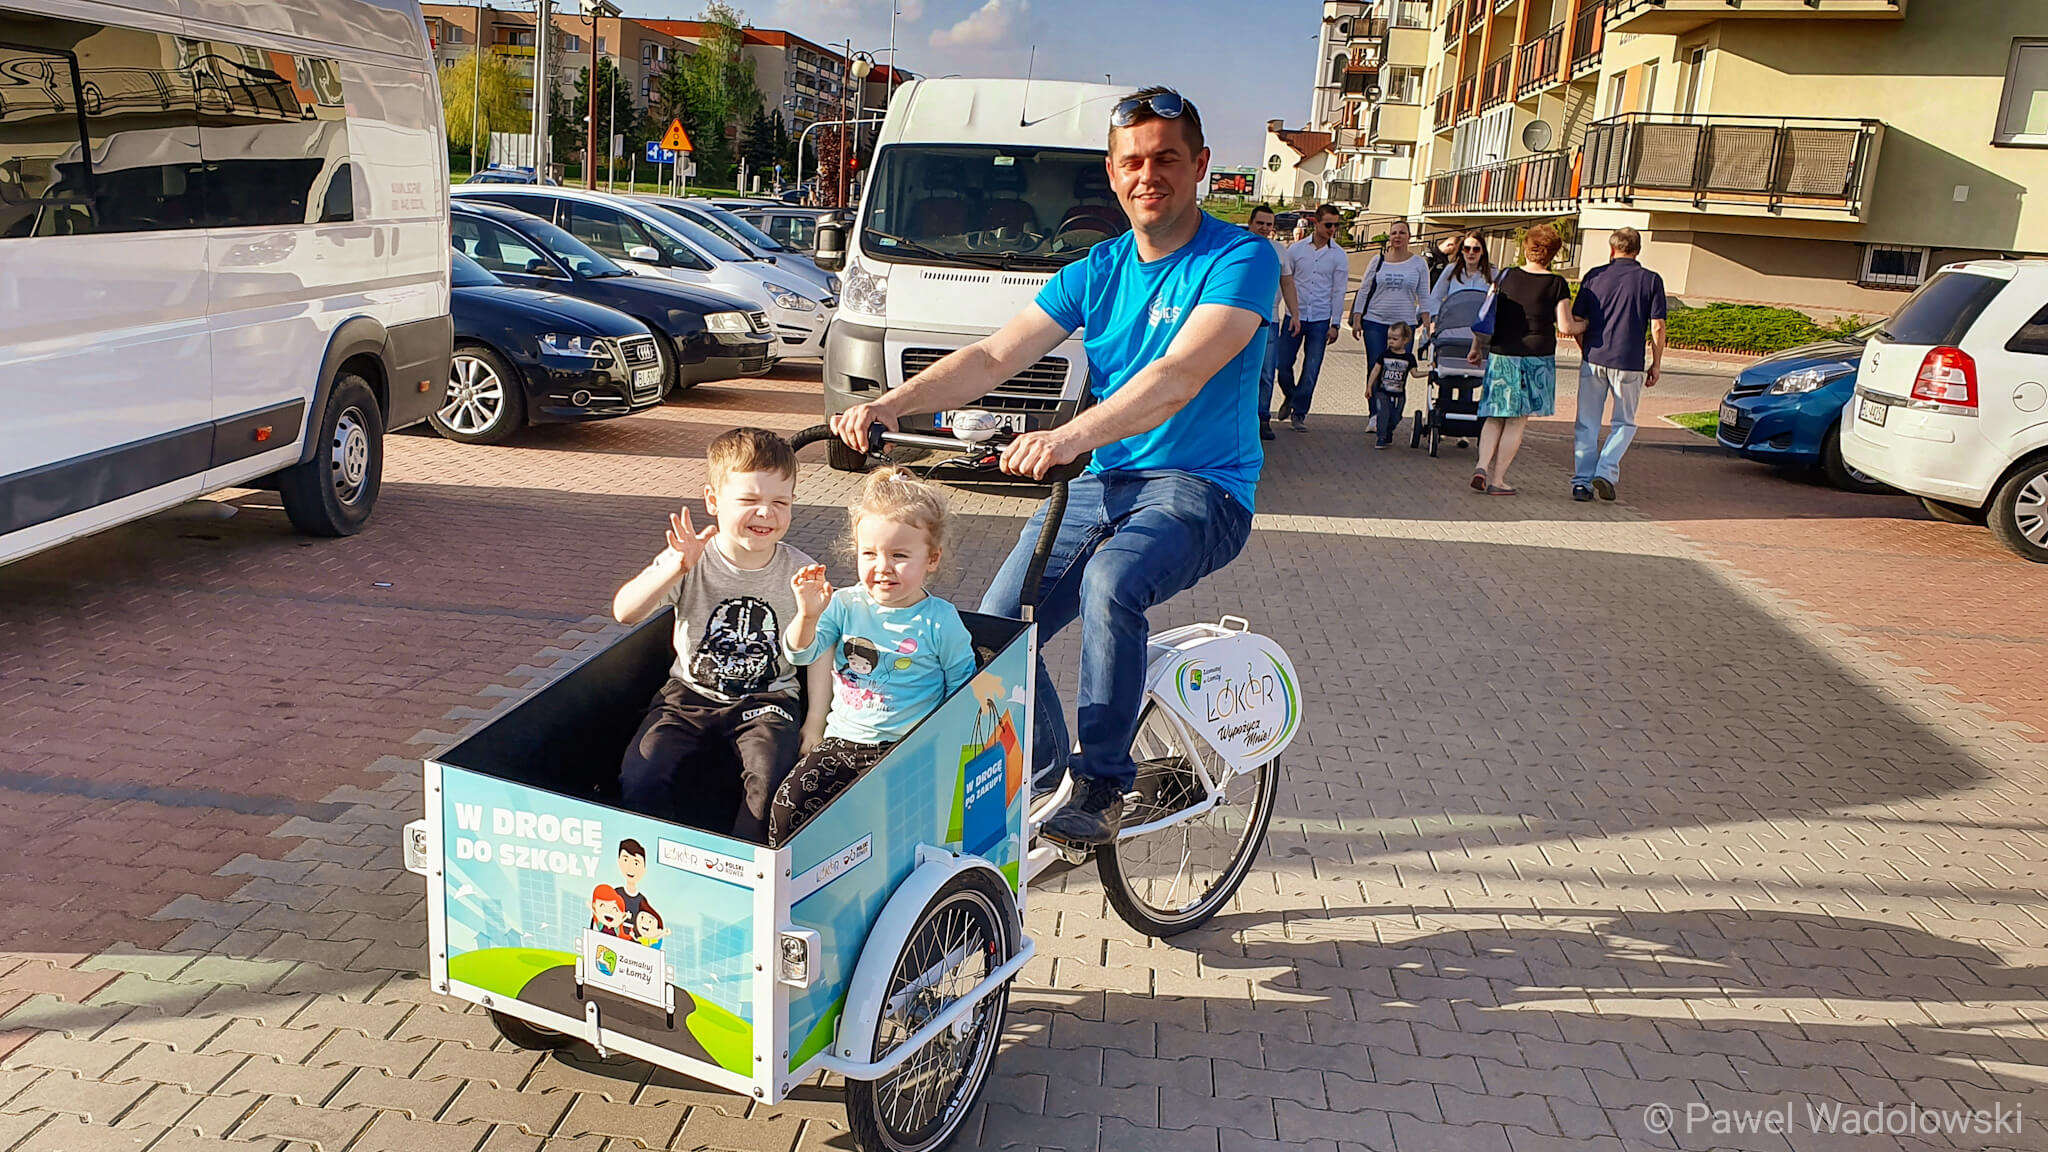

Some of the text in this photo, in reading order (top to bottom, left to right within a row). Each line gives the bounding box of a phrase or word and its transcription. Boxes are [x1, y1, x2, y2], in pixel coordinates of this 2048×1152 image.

[1384, 370, 1404, 380] BOSS
[1217, 720, 1261, 742] Wypożycz
[1243, 727, 1272, 748] Mnie!
[965, 773, 1002, 807] PO ZAKUPY
[966, 780, 974, 794] W
[455, 803, 602, 854] W DROGĘ
[456, 837, 600, 878] DO SZKOŁY
